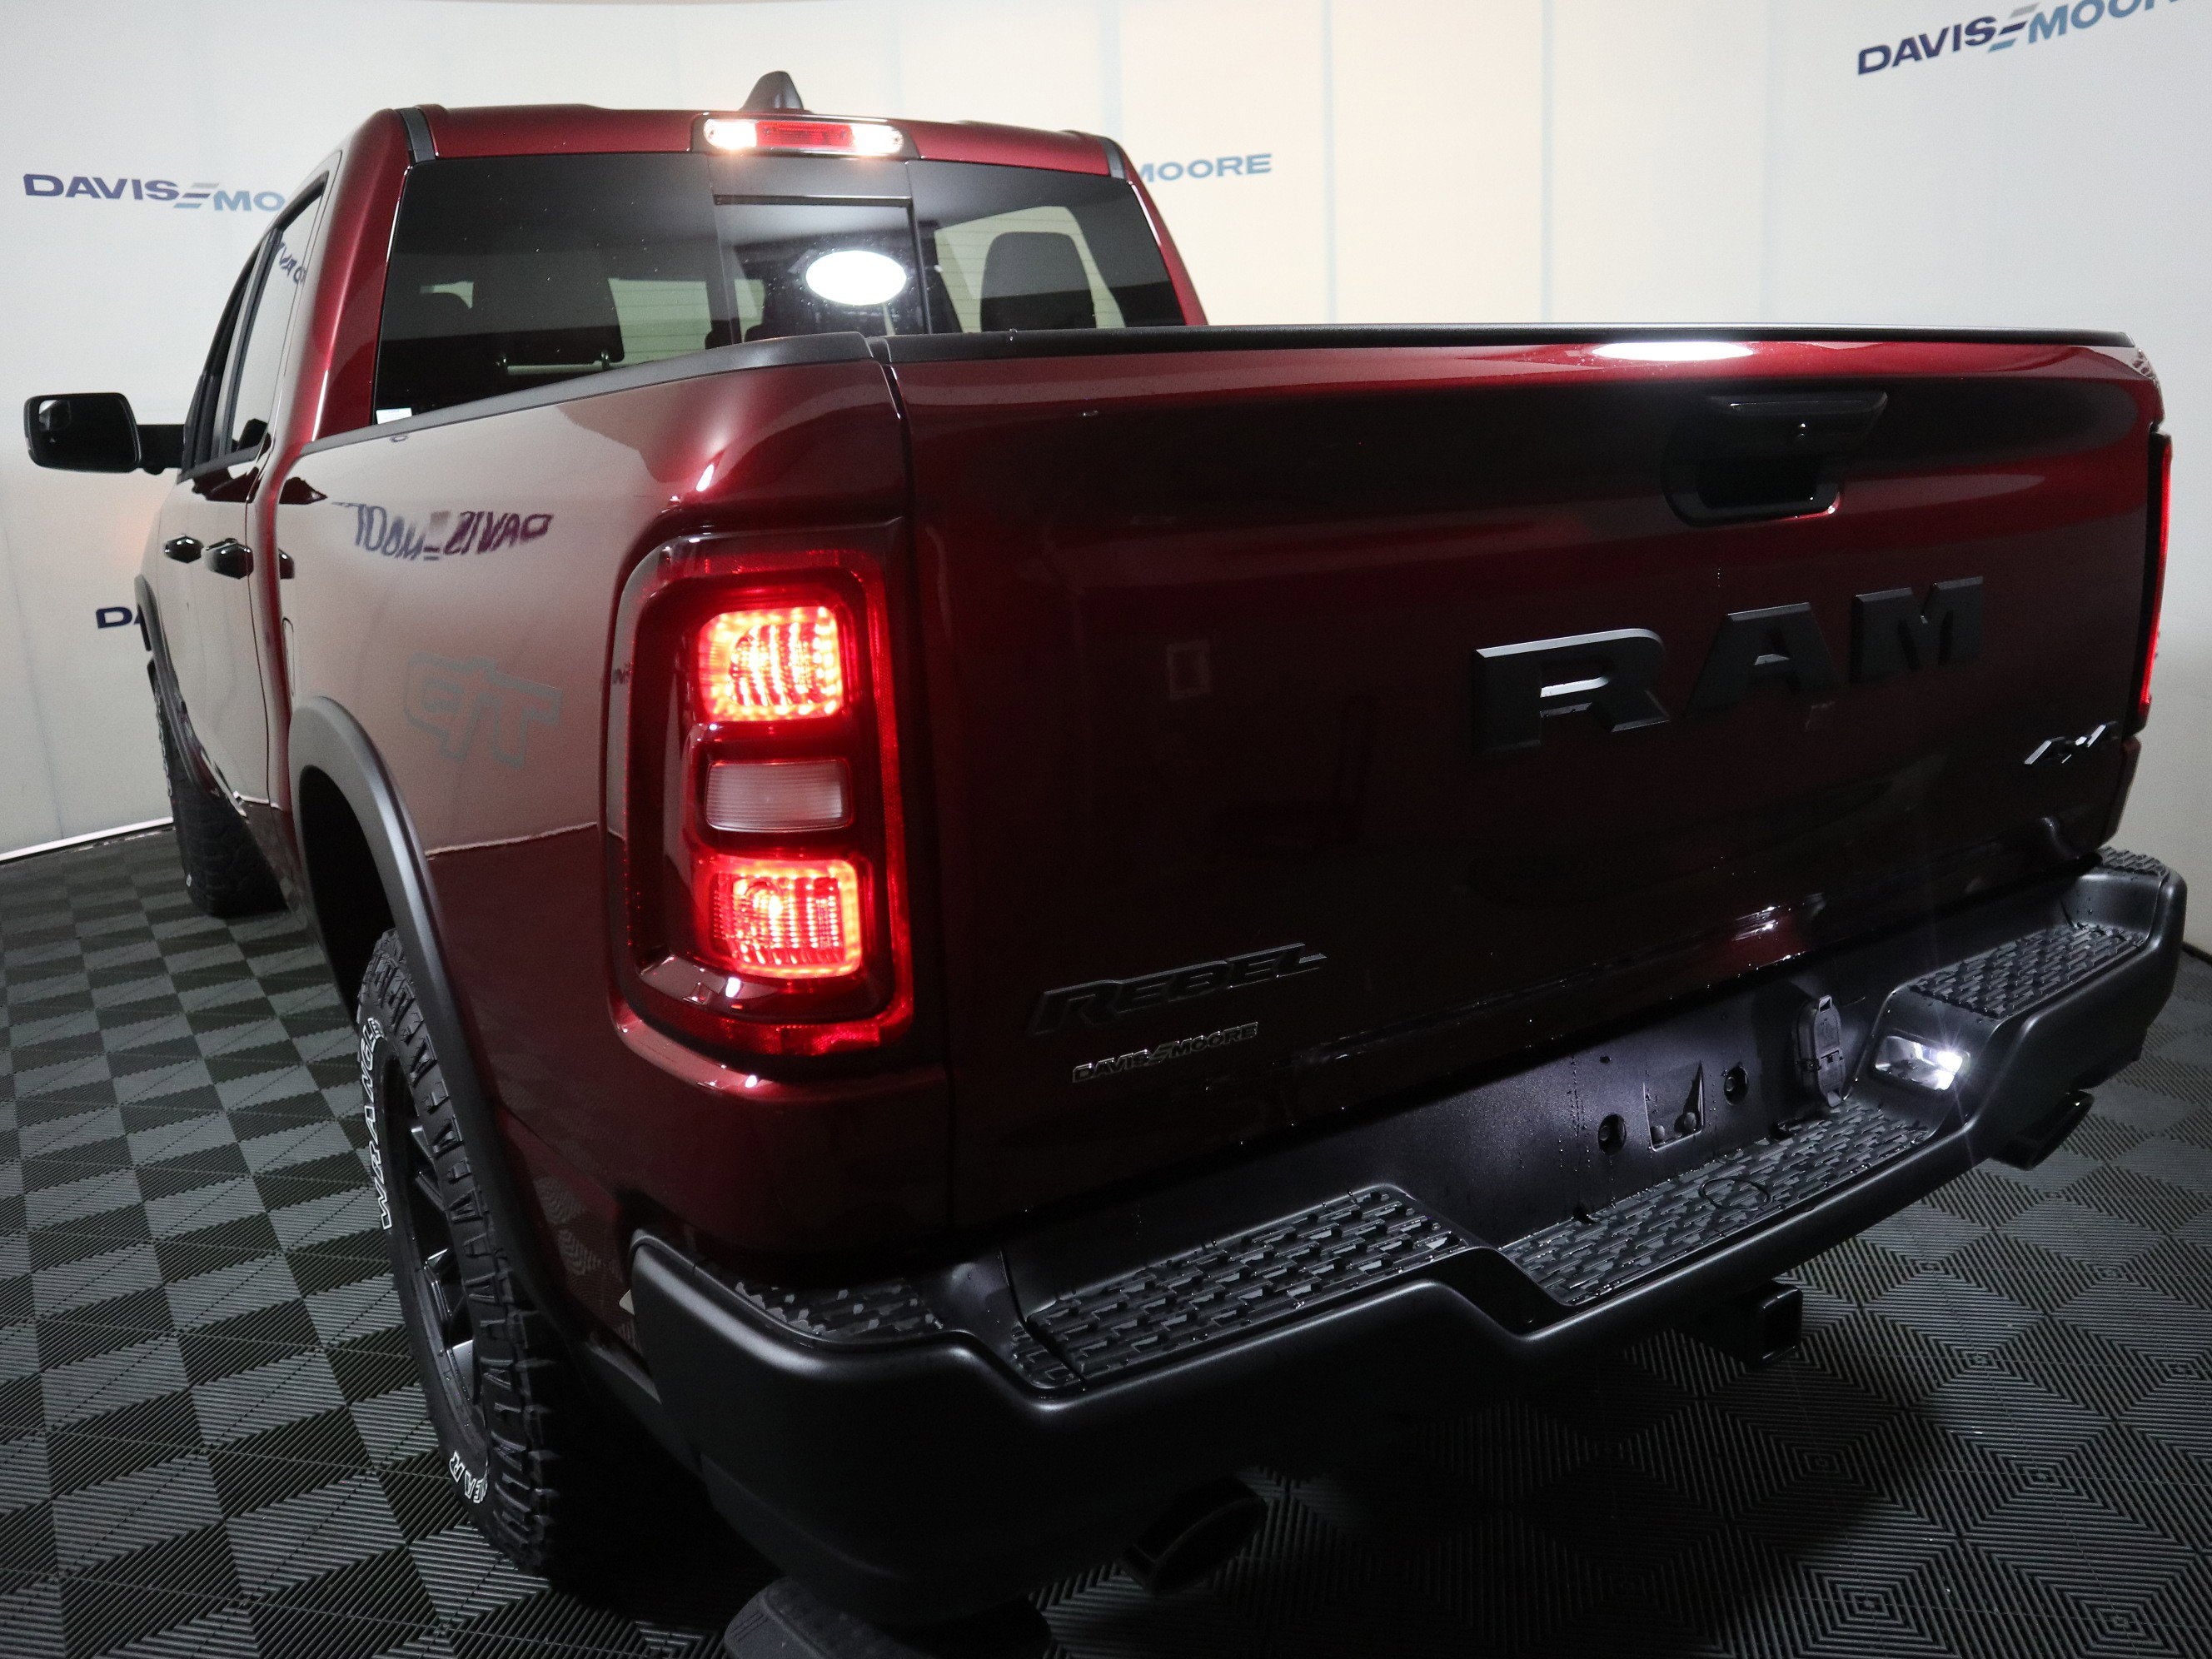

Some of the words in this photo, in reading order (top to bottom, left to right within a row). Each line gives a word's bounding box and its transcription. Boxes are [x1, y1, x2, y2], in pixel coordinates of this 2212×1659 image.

[1856, 15, 1997, 76] DAVIS
[2028, 0, 2179, 43] MOO
[22, 172, 180, 202] DAVIS
[1471, 575, 1984, 755] RAM
[1026, 941, 1328, 1037] REBEL
[1072, 1049, 1152, 1084] DAVIS
[1168, 1021, 1259, 1059] MOORE
